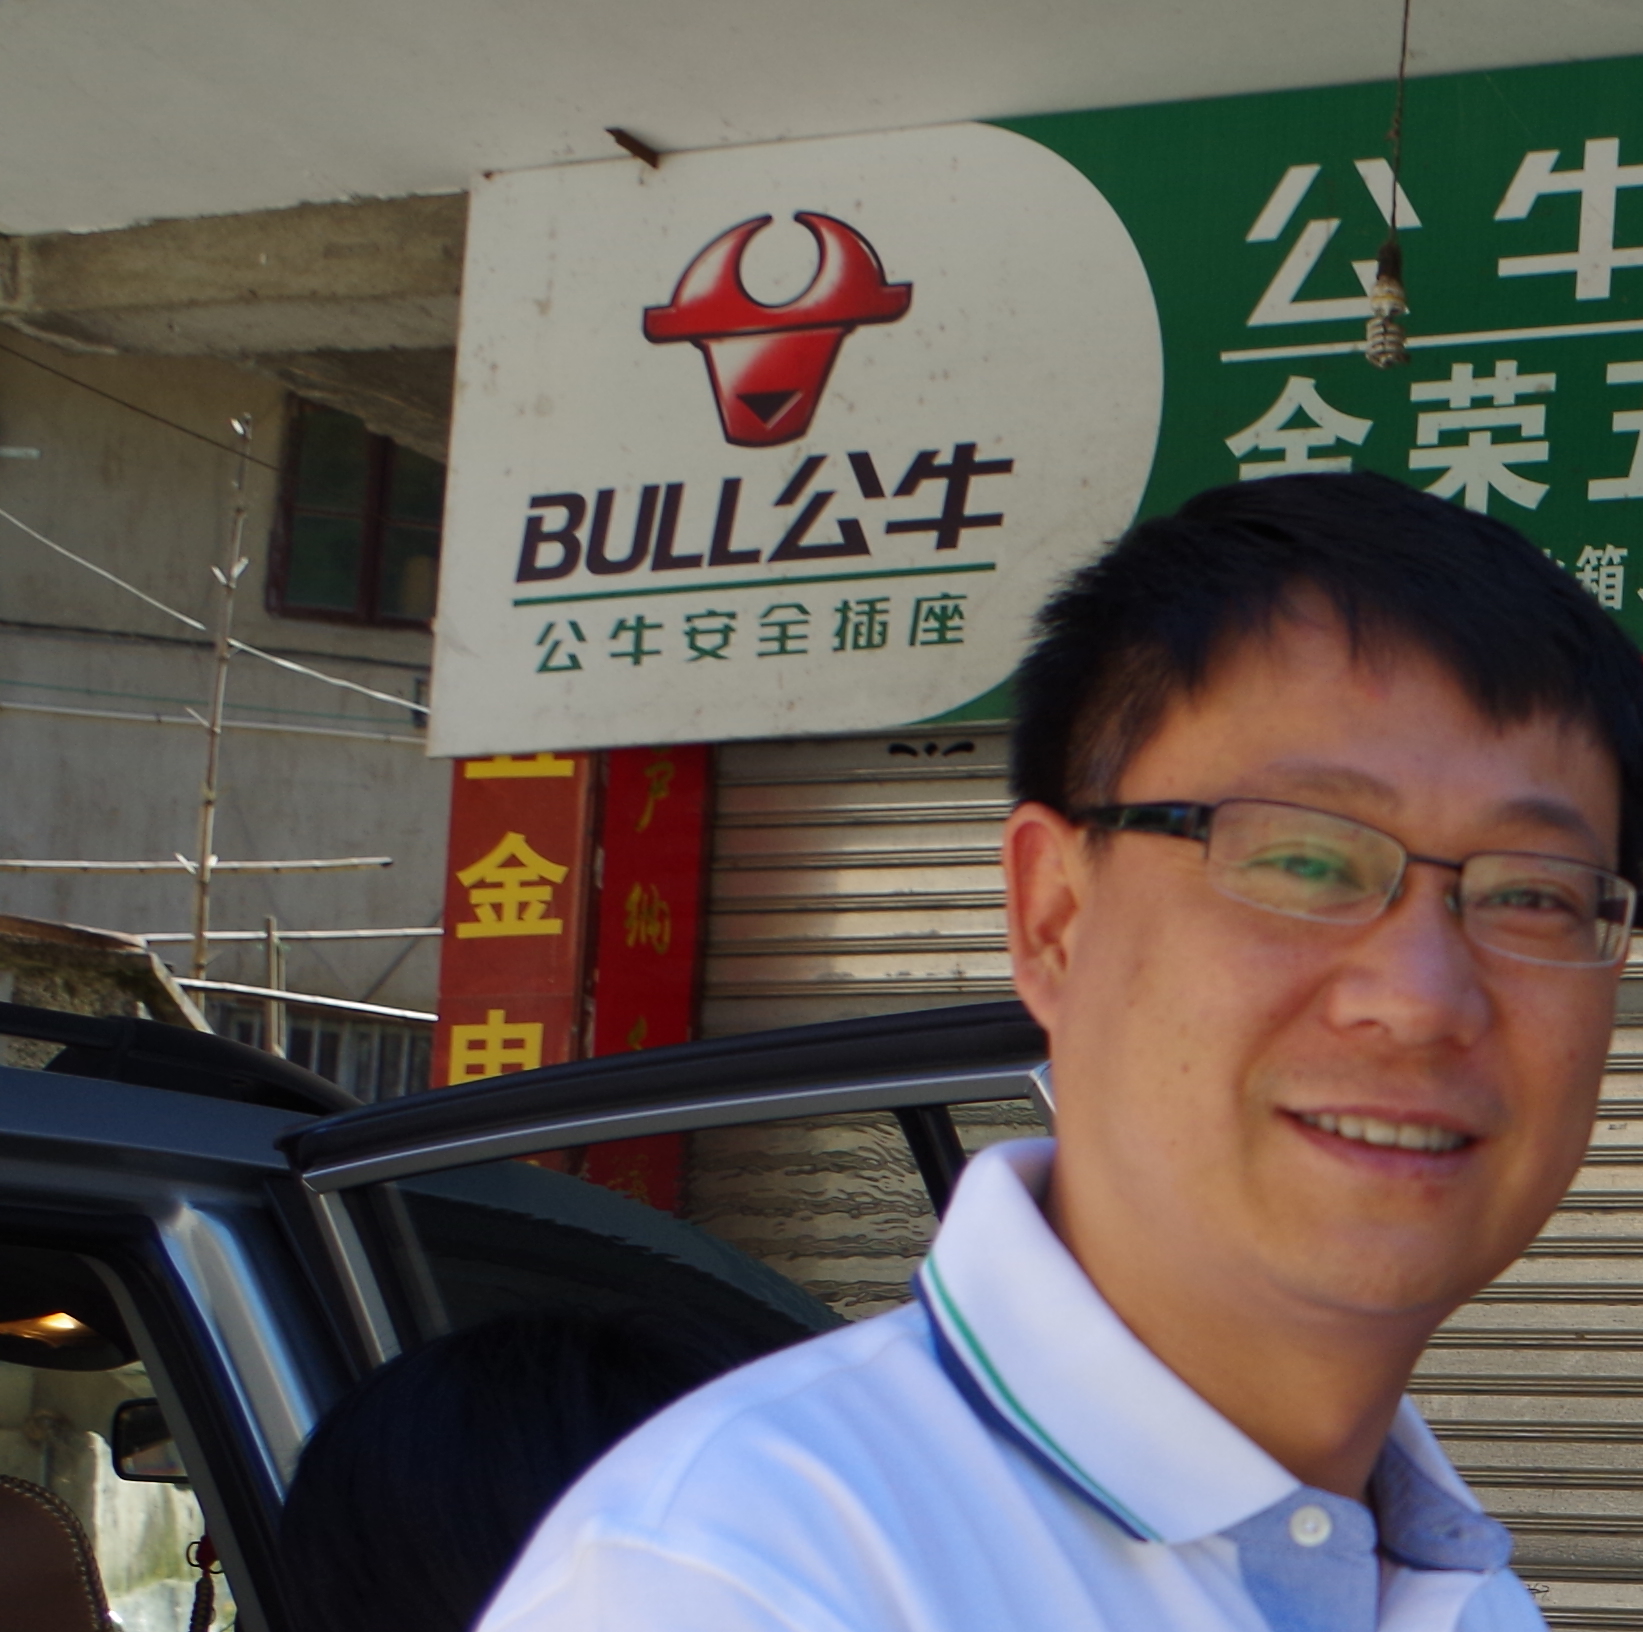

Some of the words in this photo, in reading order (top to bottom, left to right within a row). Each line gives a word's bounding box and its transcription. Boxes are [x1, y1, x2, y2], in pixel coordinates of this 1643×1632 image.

[536, 594, 967, 674] 公牛安全插座
